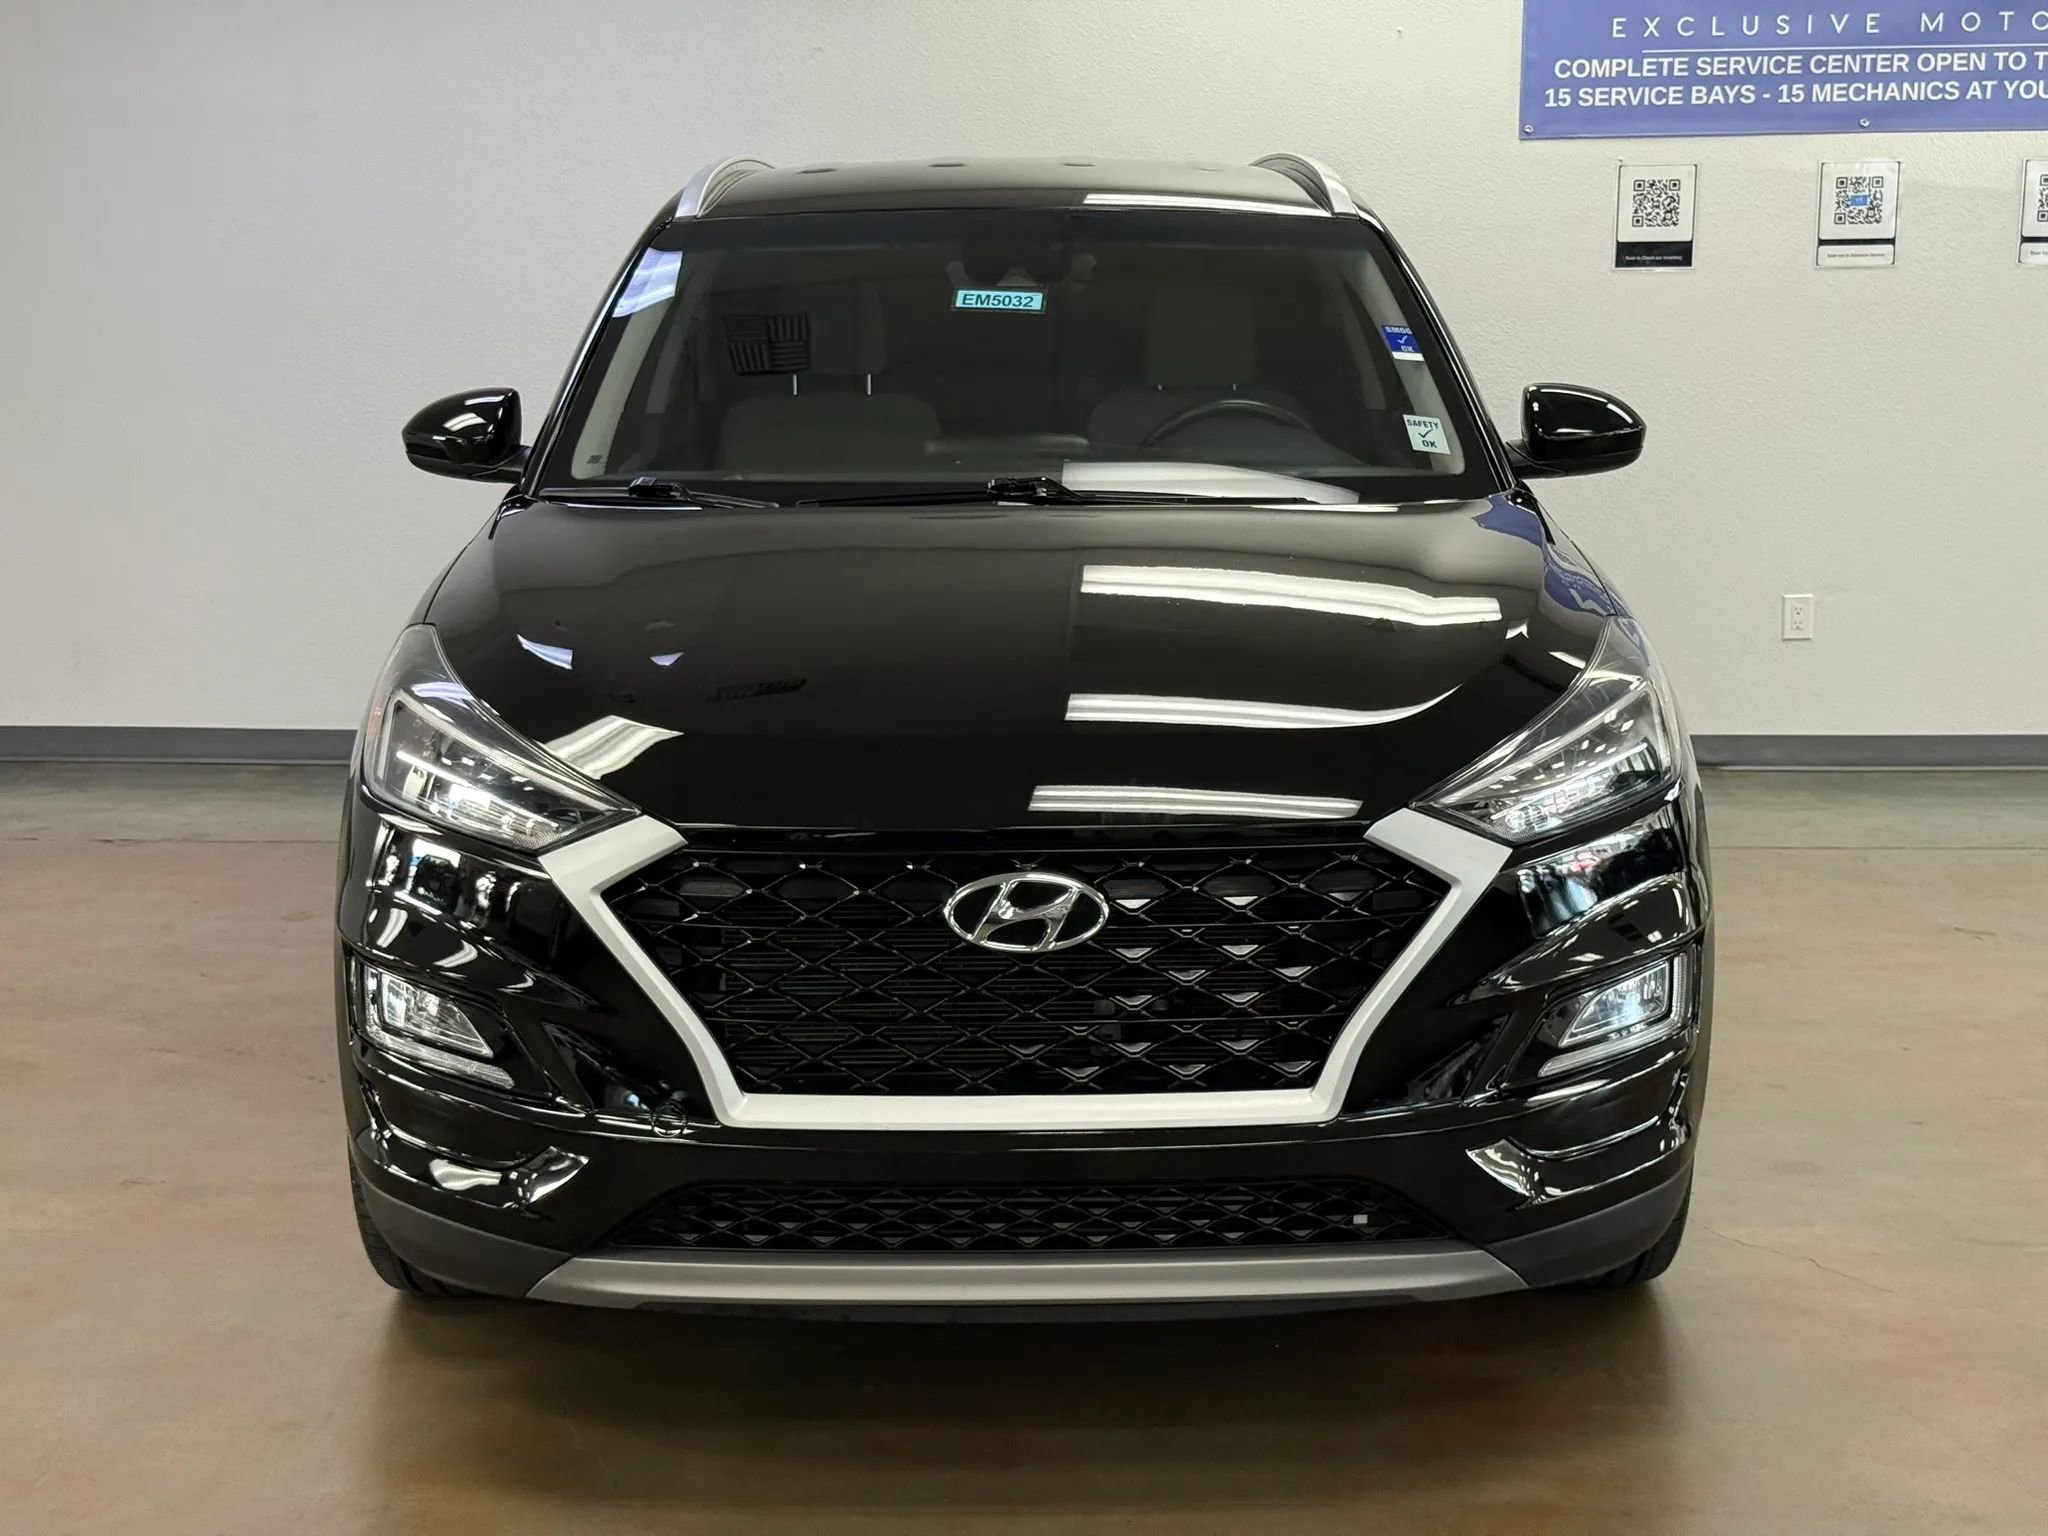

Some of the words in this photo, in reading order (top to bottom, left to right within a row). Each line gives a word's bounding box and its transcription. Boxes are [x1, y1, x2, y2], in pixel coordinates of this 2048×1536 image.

[1612, 13, 1881, 38] EXCLUSIVE
[1554, 57, 1690, 79] COMPLETE
[1695, 55, 1803, 77] SERVICE
[1809, 53, 1910, 75] CENTER
[1916, 52, 1986, 73] OPEN
[1993, 51, 2027, 71] TO
[1544, 88, 1572, 108] 15
[1578, 86, 1684, 107] SERVICE
[1690, 84, 1757, 105] BAYS
[1777, 83, 1805, 104] 15
[1811, 81, 1960, 103] MECHANICS
[1965, 80, 1998, 100] AT
[962, 294, 1034, 307] EM5032
[1406, 419, 1439, 430] SAFETY
[1422, 440, 1437, 448] OK
